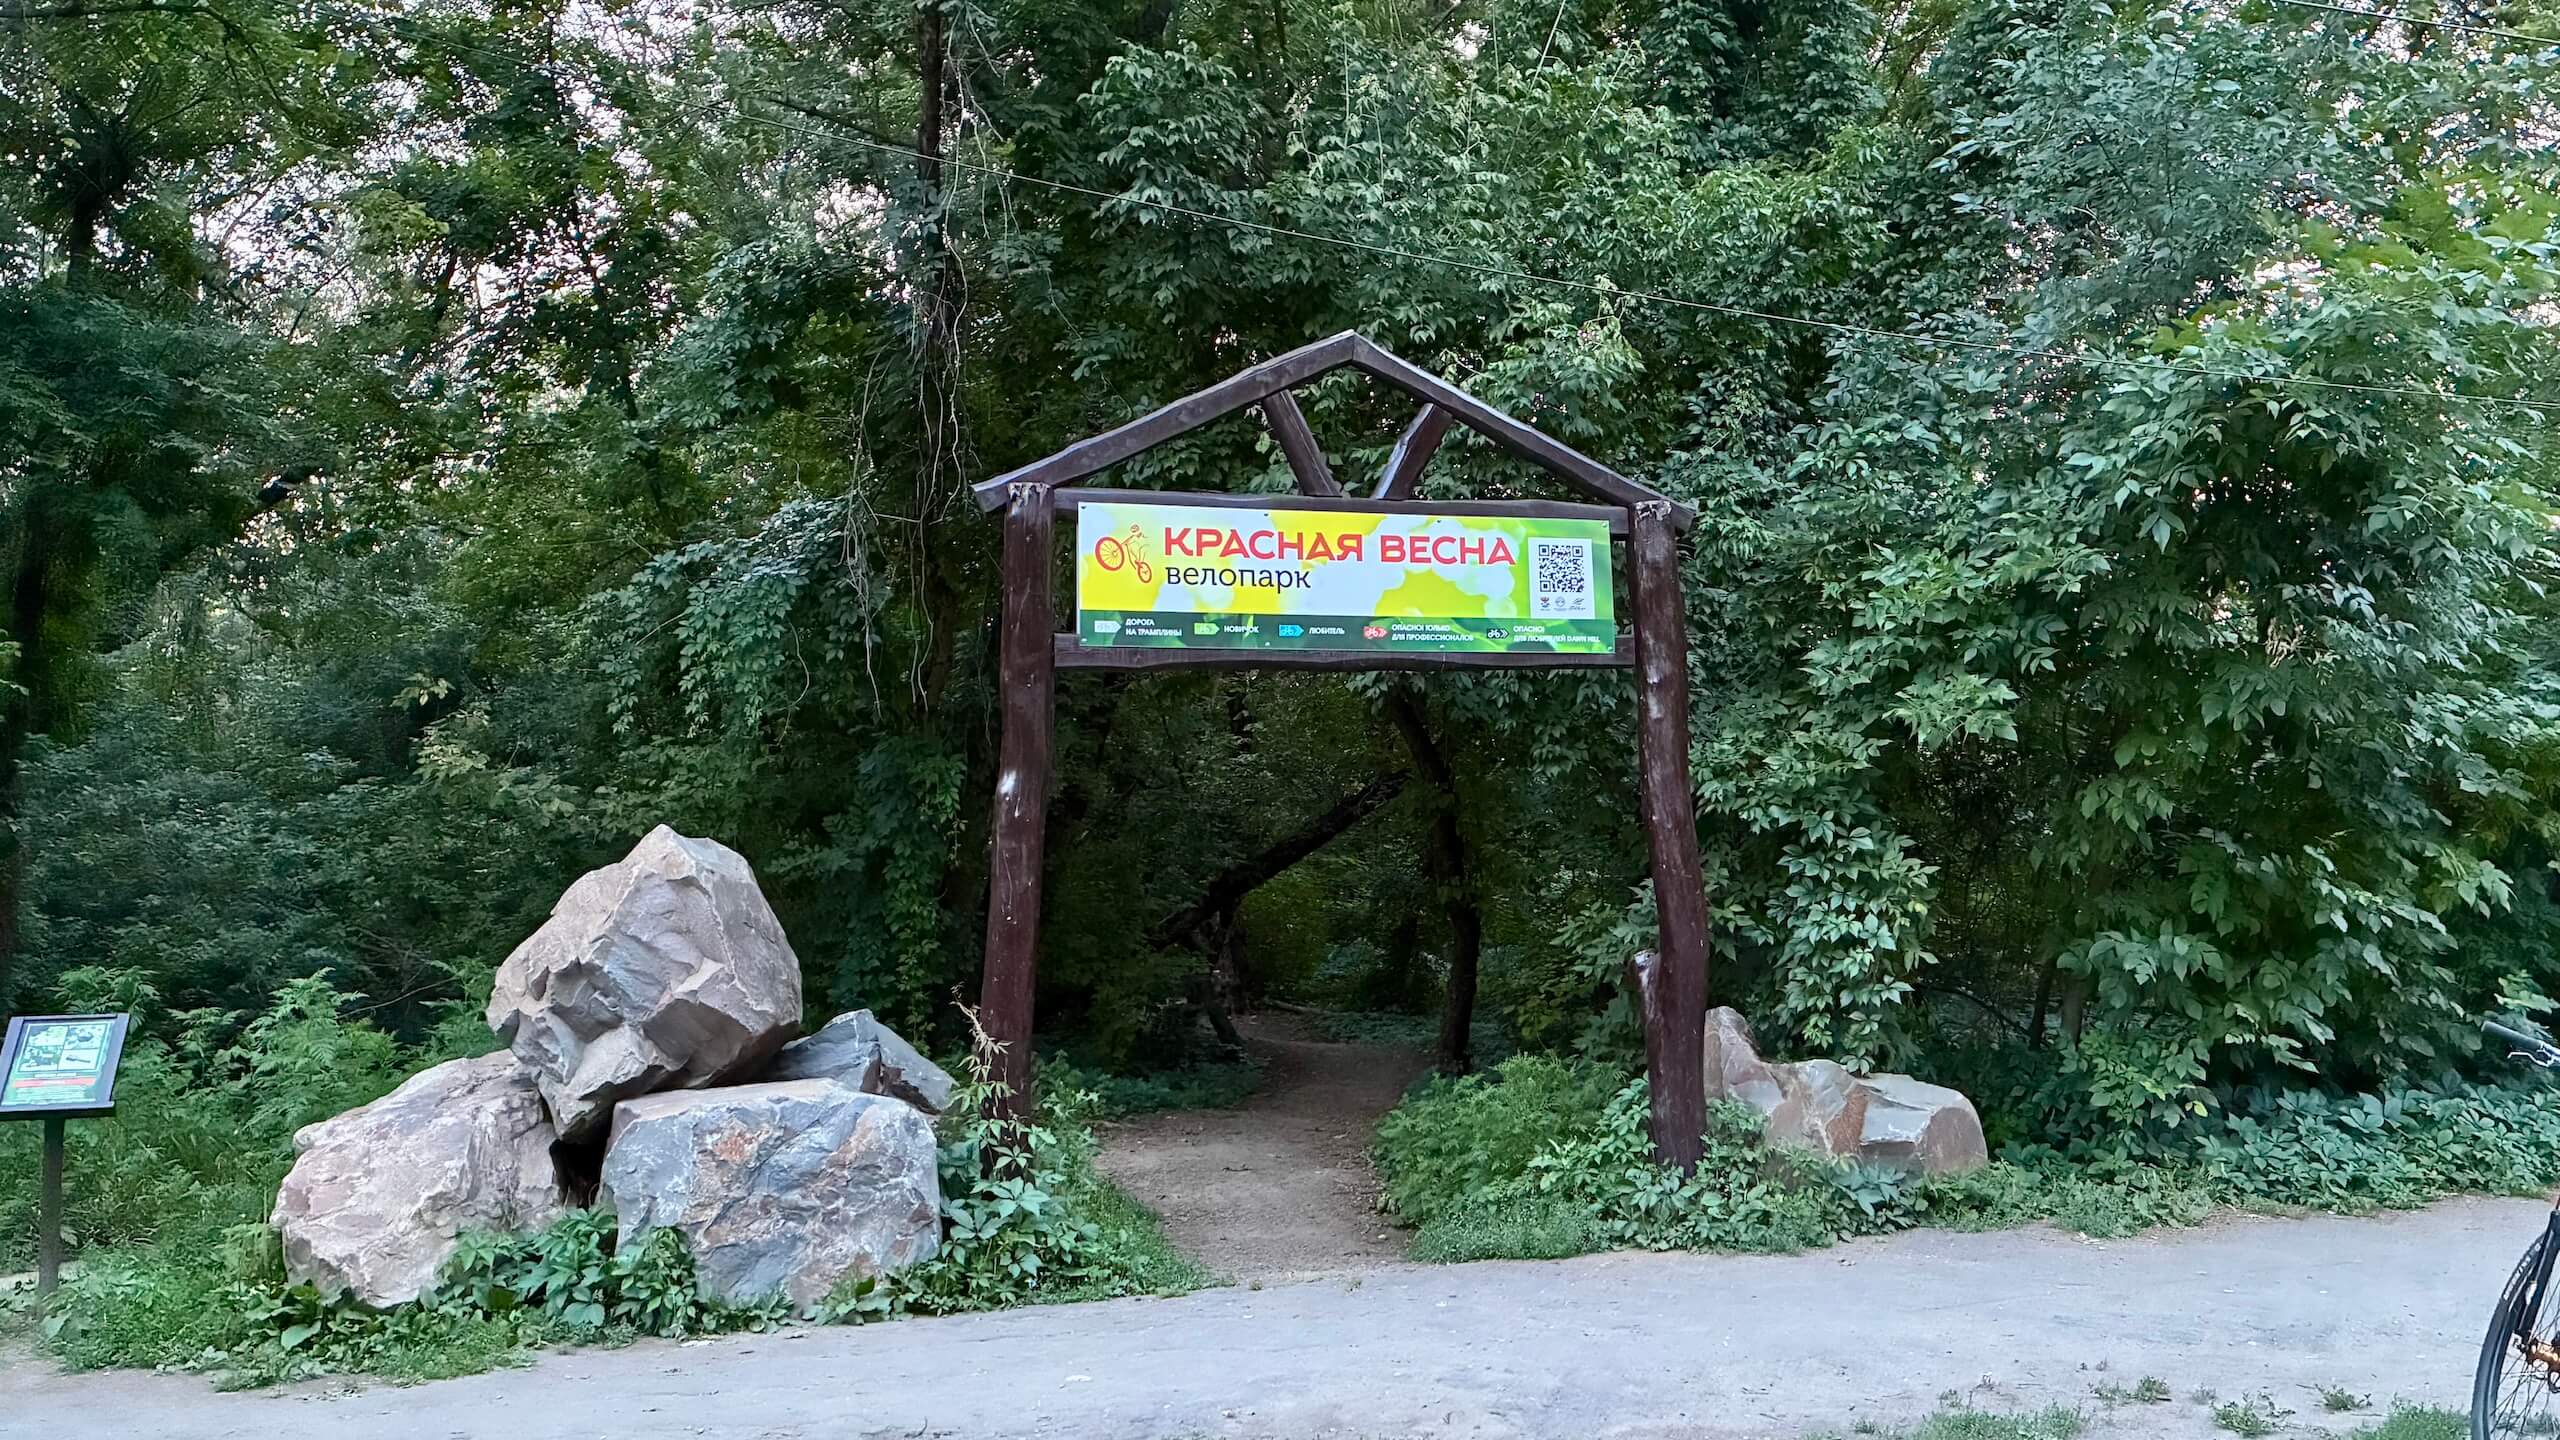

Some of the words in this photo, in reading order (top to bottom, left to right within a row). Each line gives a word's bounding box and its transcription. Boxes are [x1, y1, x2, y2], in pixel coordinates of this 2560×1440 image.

[1164, 527, 1363, 562] КРАСНАЯ
[1380, 535, 1516, 565] ВЕСНА
[1165, 567, 1311, 594] велопарк
[1125, 618, 1155, 626] ДОРОГА
[1125, 628, 1136, 636] НА
[1137, 628, 1183, 637] ТРАМПЛИНЫ
[1223, 625, 1260, 634] НОВИЧОК
[1308, 627, 1346, 635] ЛЮБИТЕЛЬ
[1391, 633, 1405, 641] ДЛЯ
[1406, 633, 1474, 641] ПРОФЕССИОНАЛОВ
